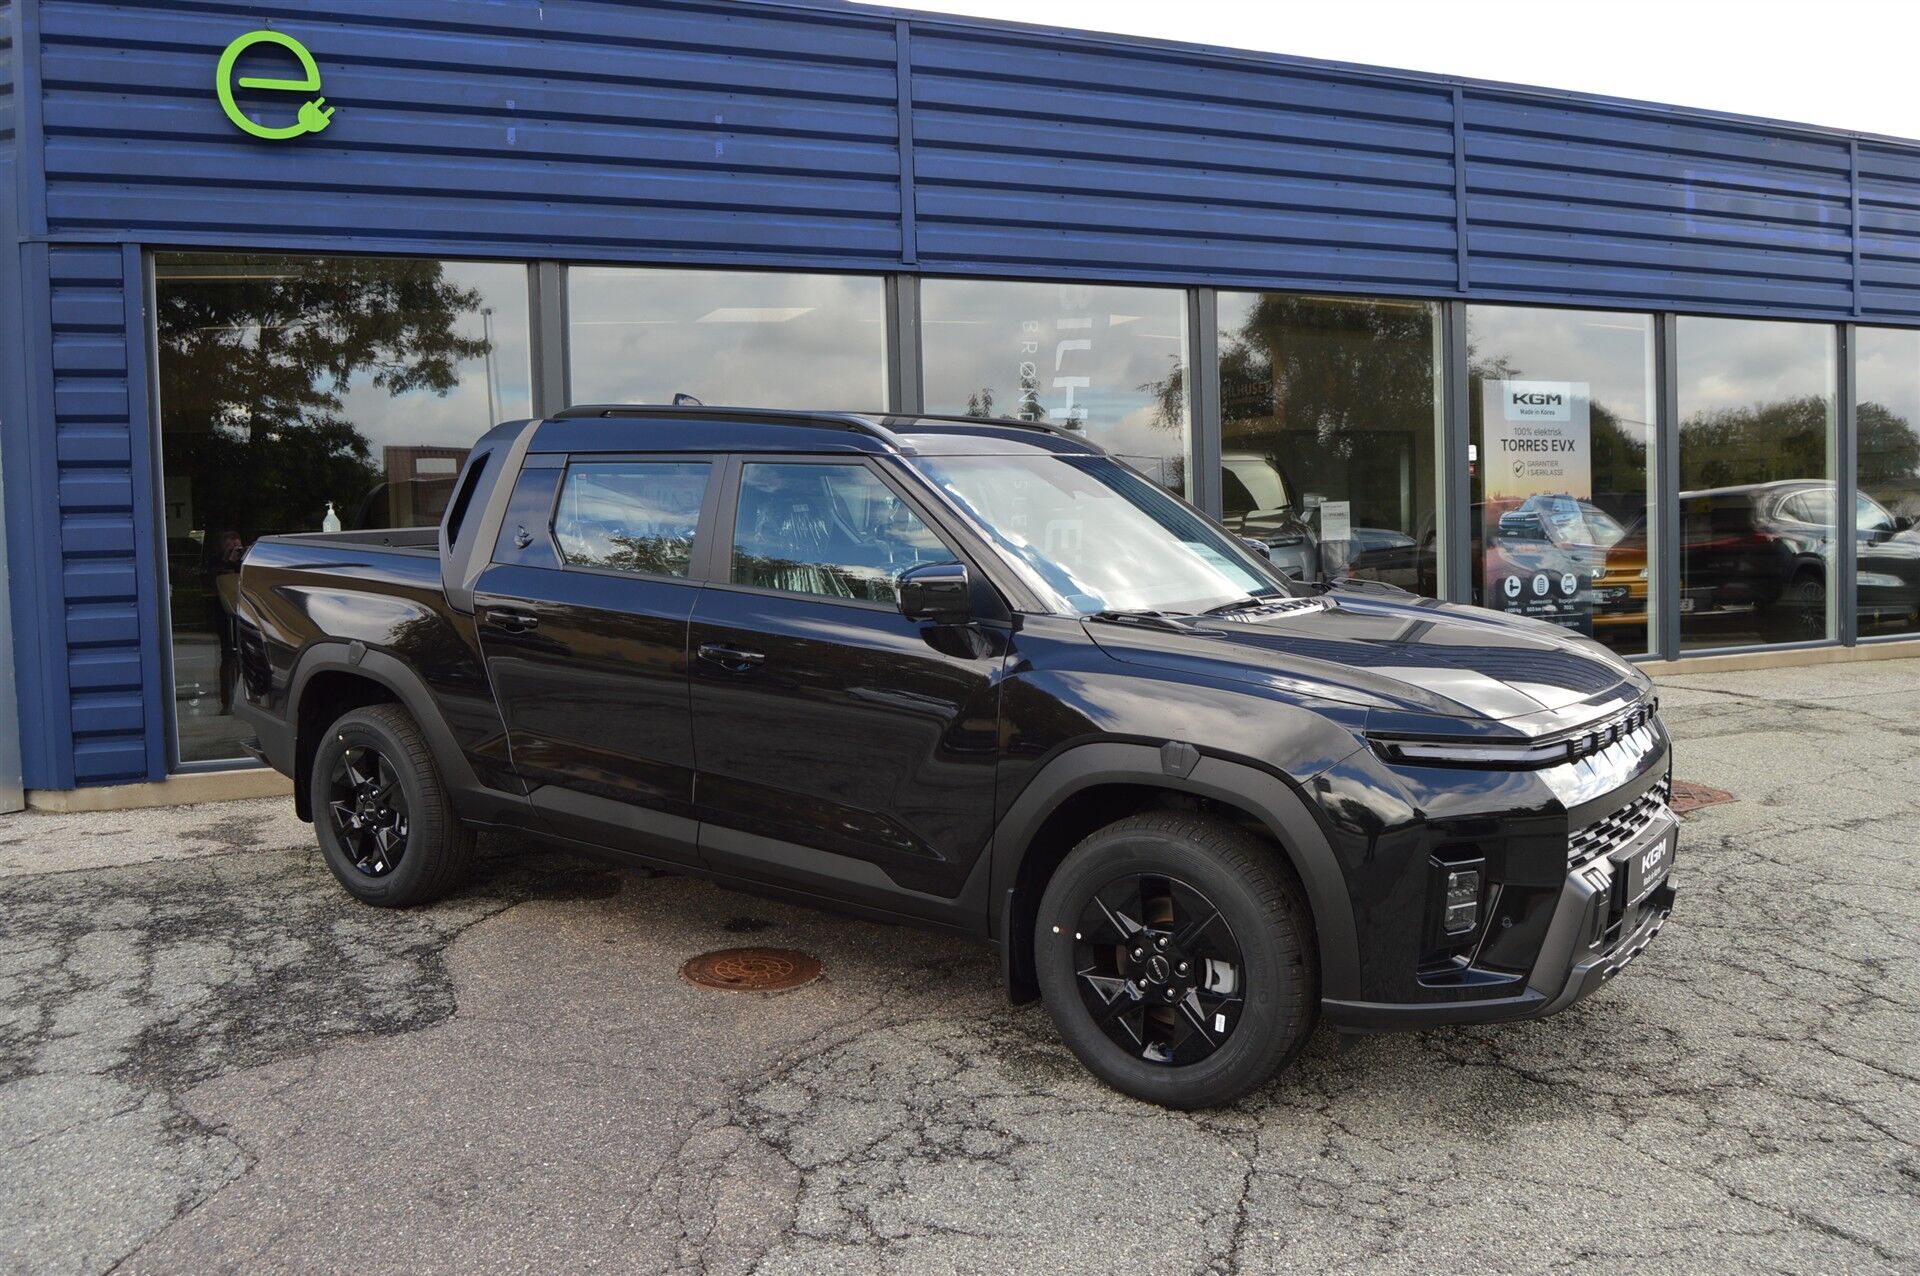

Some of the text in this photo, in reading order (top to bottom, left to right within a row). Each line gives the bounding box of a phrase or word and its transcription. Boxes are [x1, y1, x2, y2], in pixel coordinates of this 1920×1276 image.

[1512, 393, 1562, 405] KGM
[1520, 408, 1534, 416] Made
[1541, 408, 1556, 416] Korea
[1514, 427, 1562, 437] 100% elektrisk
[1501, 439, 1576, 452] TORRES EVX
[1641, 838, 1667, 874] KGM
